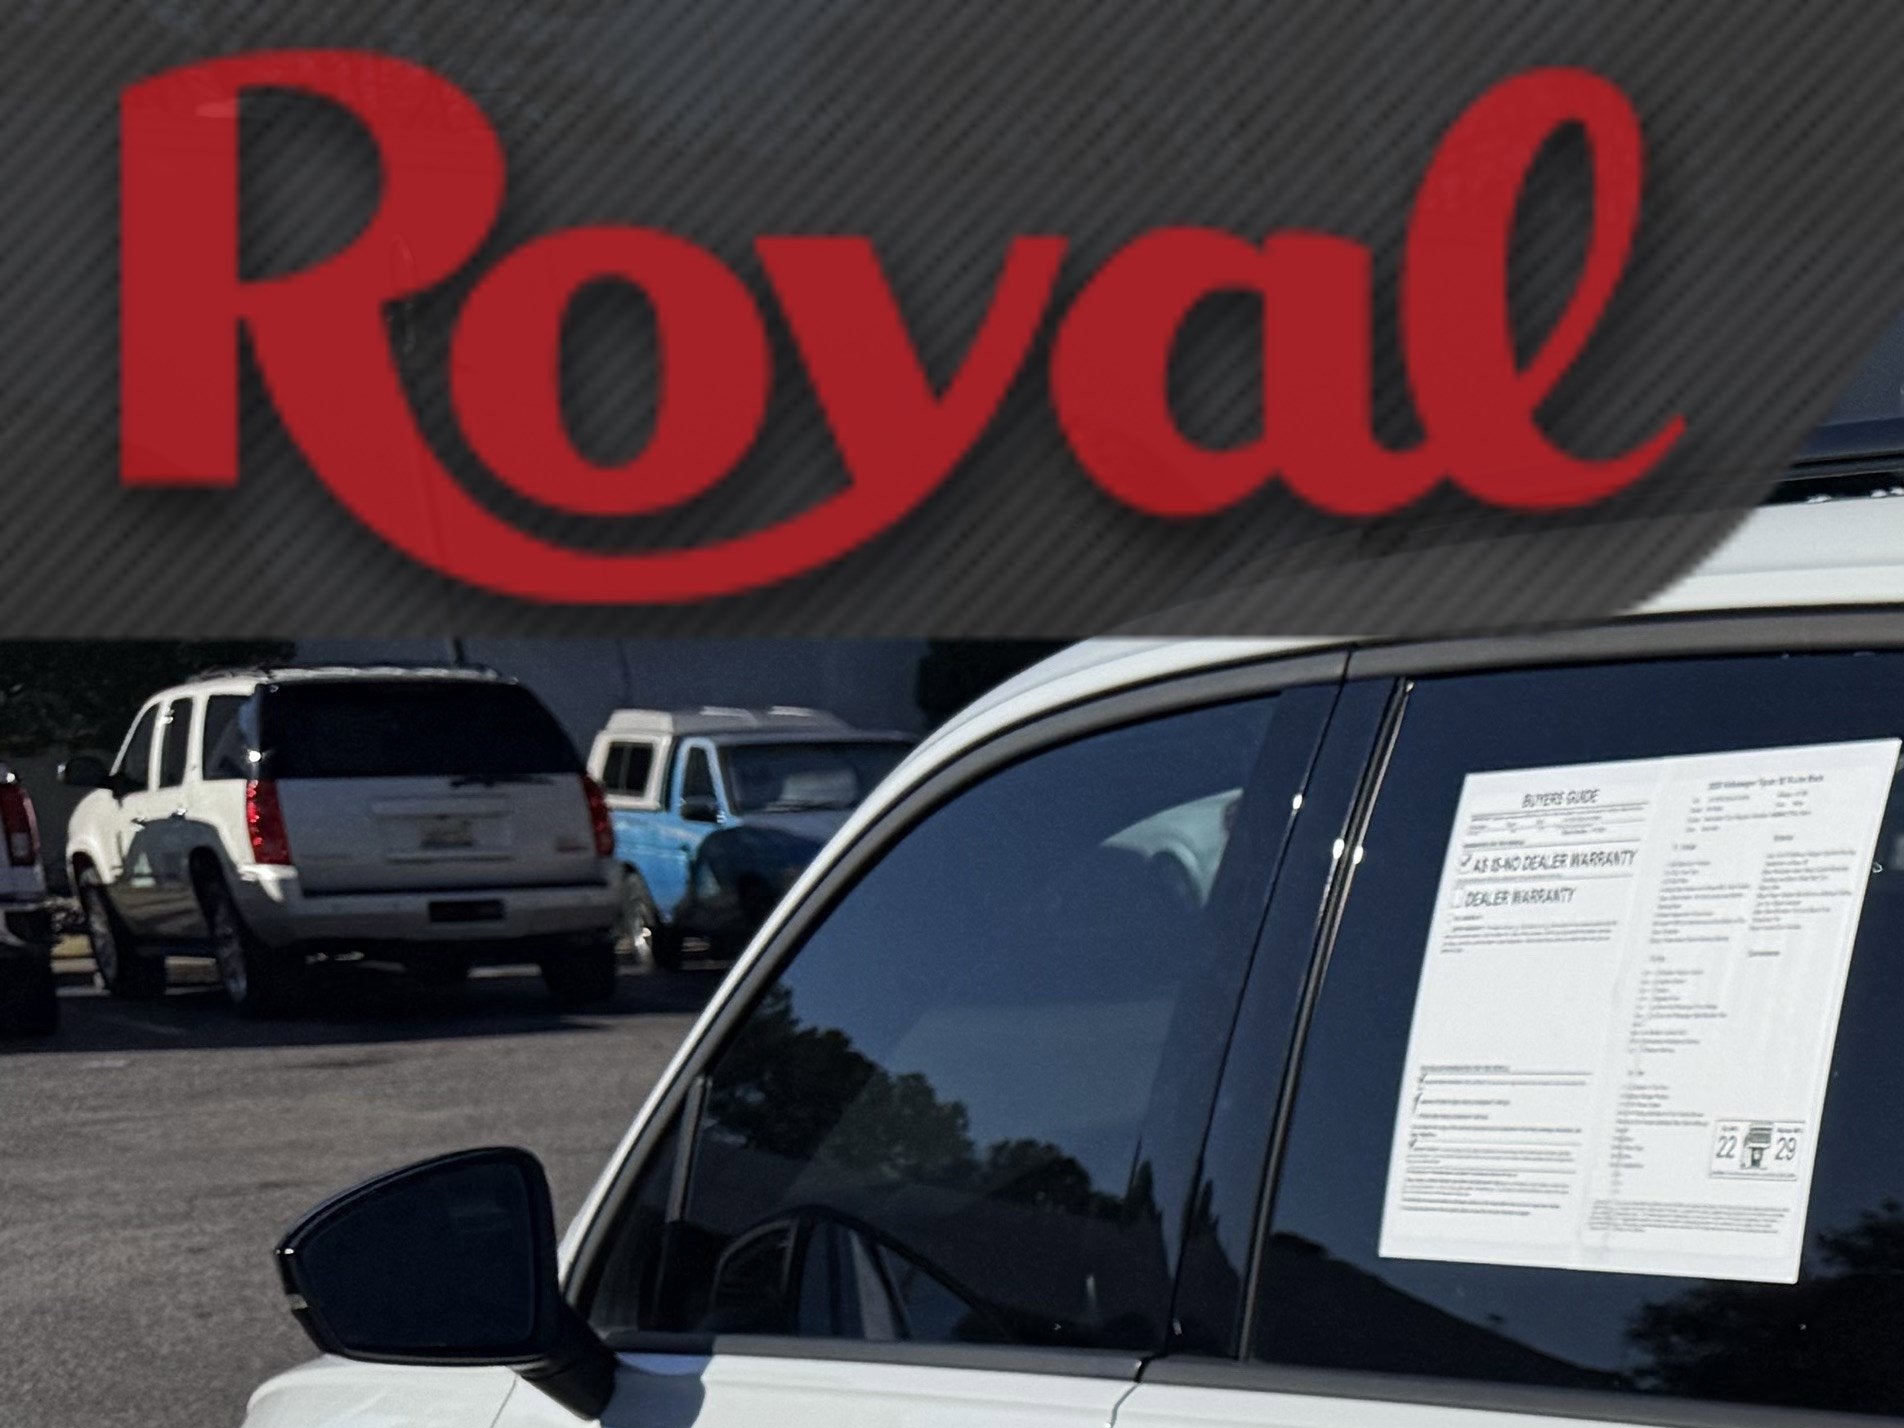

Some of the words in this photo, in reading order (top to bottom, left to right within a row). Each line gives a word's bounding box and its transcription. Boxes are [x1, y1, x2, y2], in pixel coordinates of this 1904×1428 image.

[1566, 788, 1601, 805] GUIDE
[1522, 853, 1568, 871] DEALER
[1569, 849, 1637, 868] WARRANTY
[1464, 888, 1508, 908] DEALER
[1510, 887, 1576, 906] WARRANTY
[1716, 1135, 1738, 1159] 22
[1775, 1136, 1797, 1161] 29
